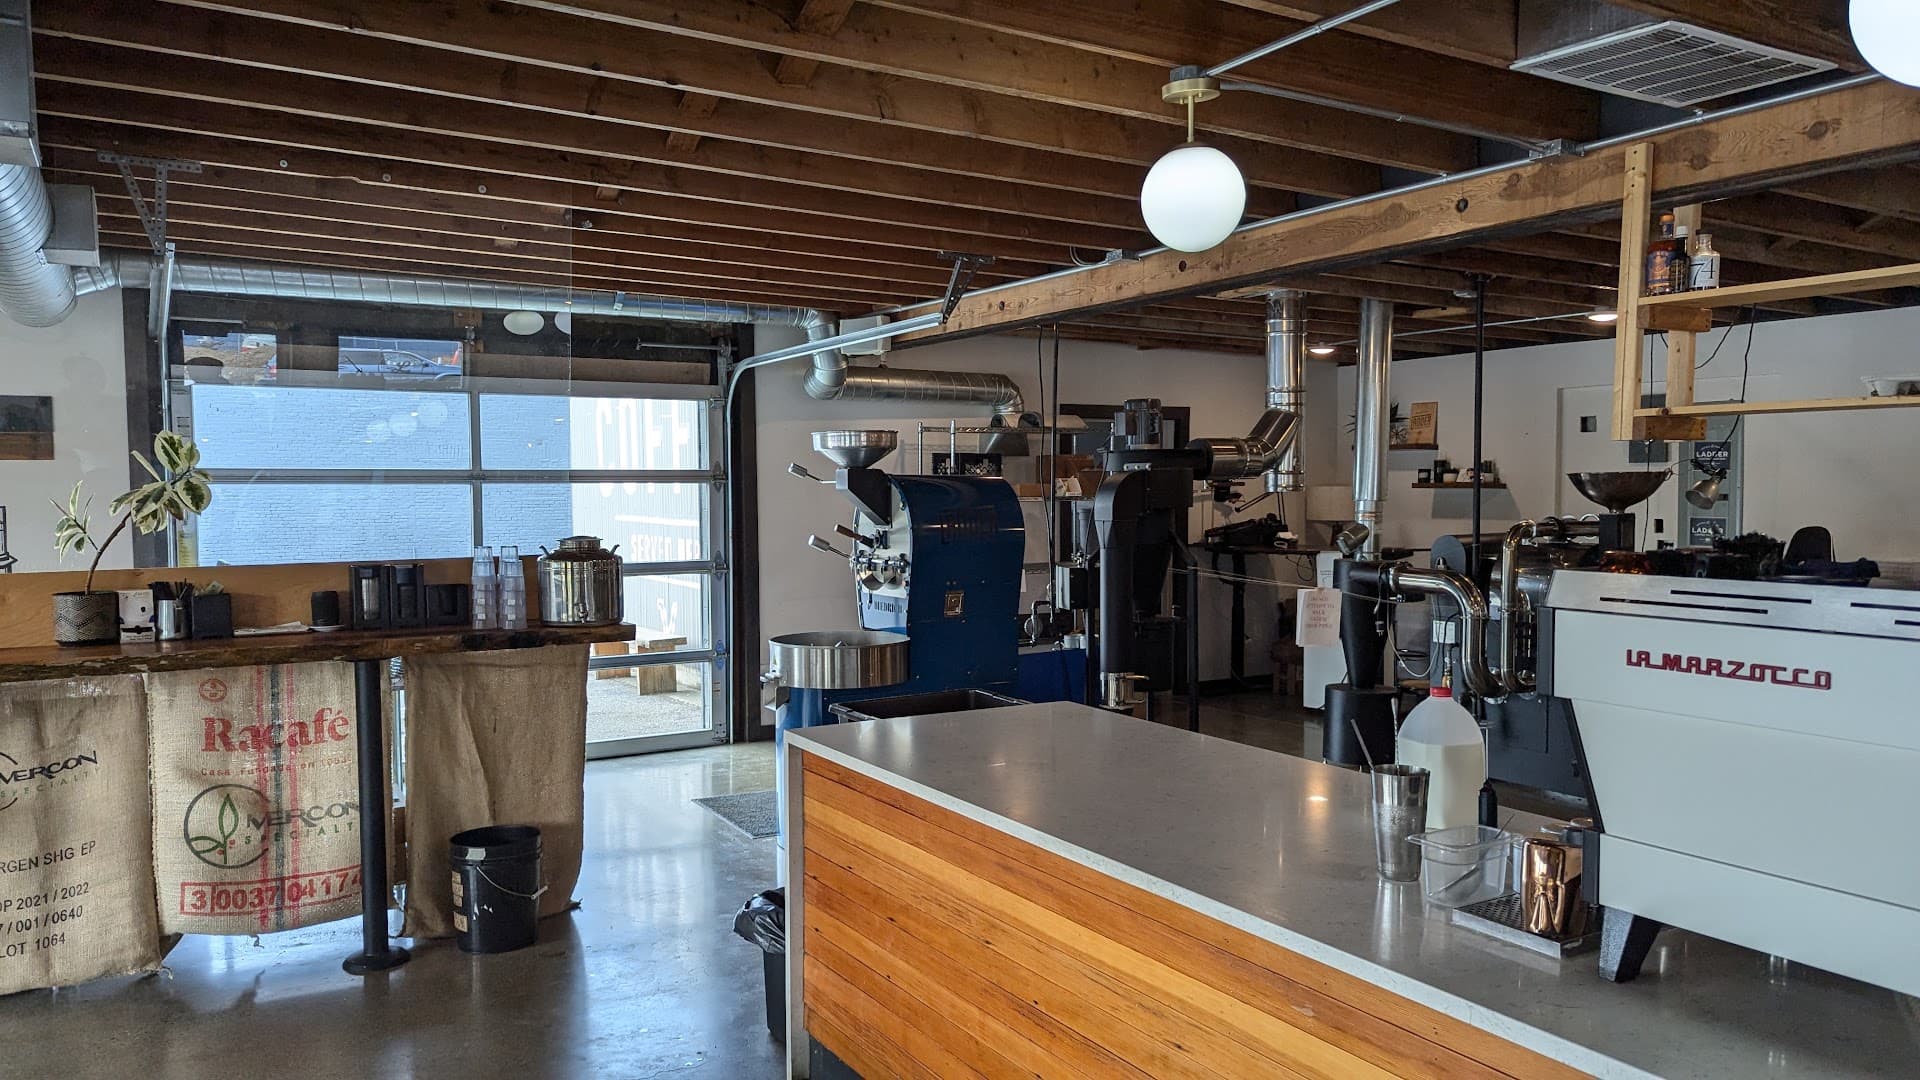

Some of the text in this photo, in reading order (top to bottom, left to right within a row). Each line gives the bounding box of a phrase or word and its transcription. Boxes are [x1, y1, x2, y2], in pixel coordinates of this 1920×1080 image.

[1626, 649, 1832, 691] LA MARZOCCO
[201, 708, 349, 753] Racafé
[43, 847, 75, 866] SHG
[81, 840, 97, 856] EP
[16, 893, 49, 911] 2021
[61, 882, 90, 900] 2022
[190, 889, 207, 910] 3
[214, 886, 280, 910] 0037
[15, 916, 40, 934] 001
[51, 905, 83, 924] 0640
[35, 932, 66, 951] 1064
